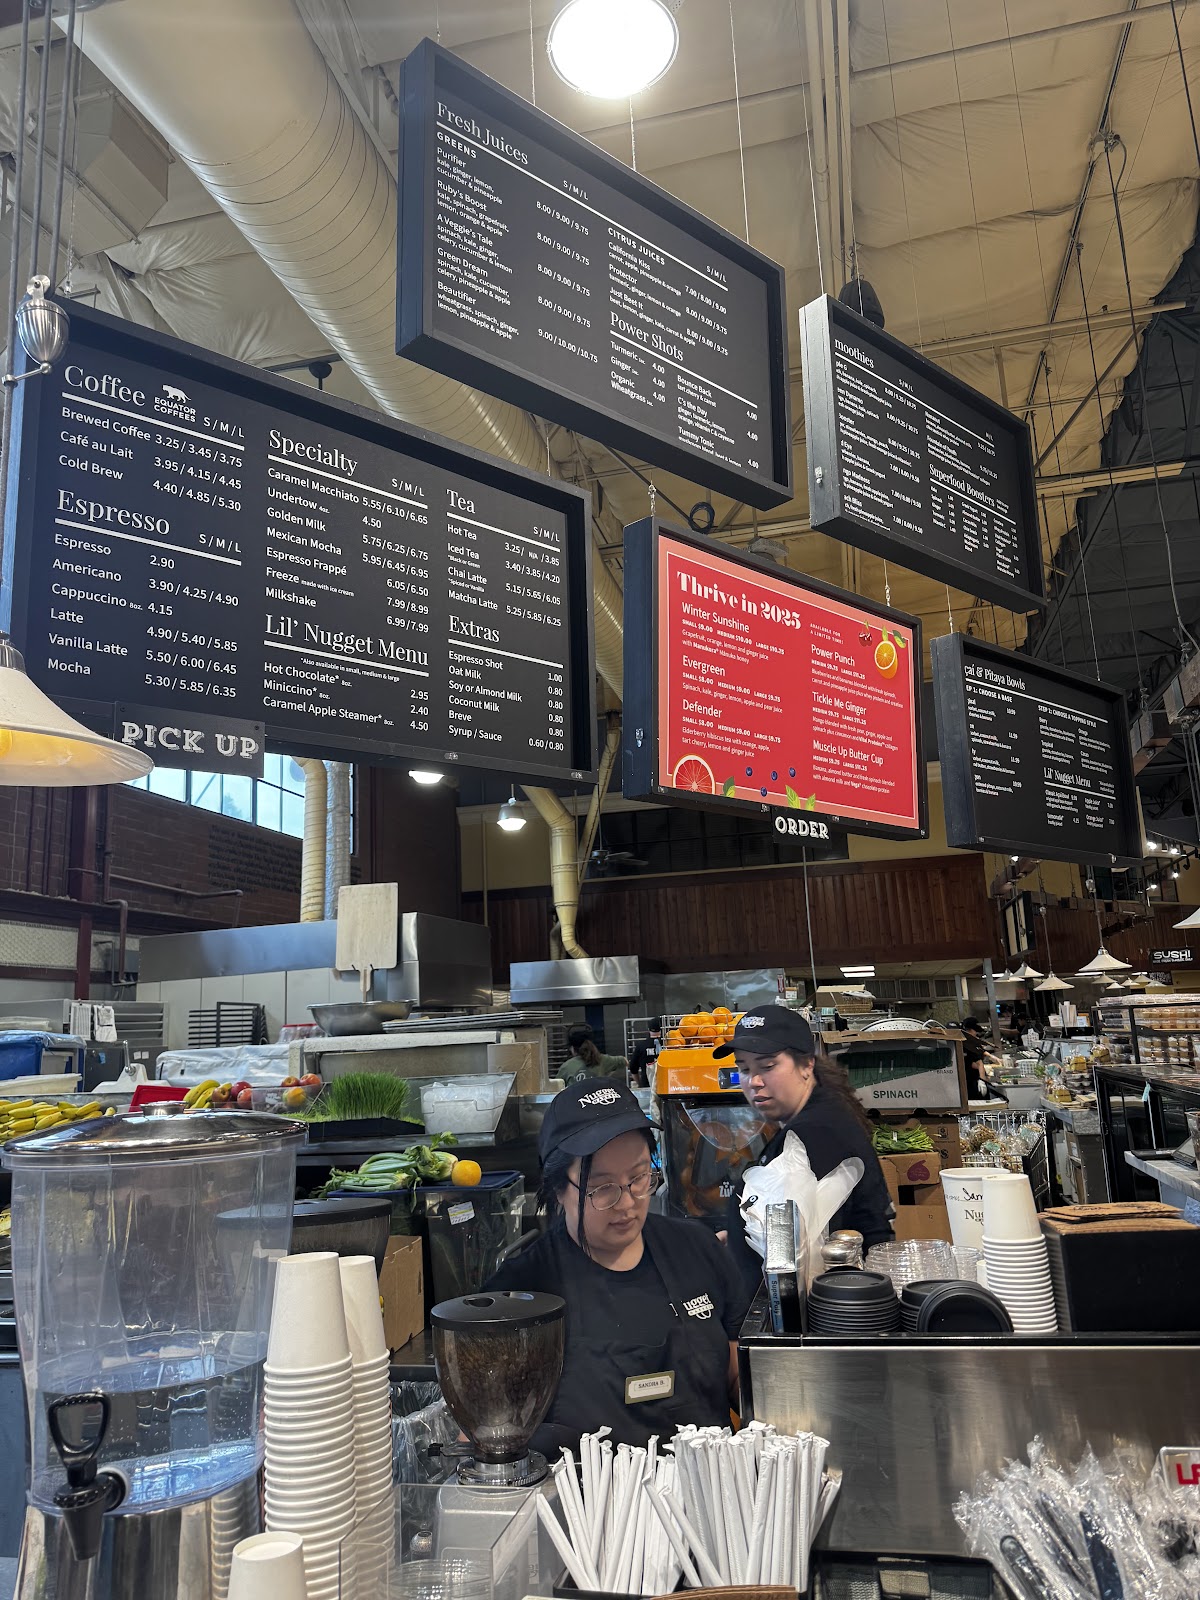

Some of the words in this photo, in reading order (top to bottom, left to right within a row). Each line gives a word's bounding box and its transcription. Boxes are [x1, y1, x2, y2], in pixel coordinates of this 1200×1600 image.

[437, 102, 481, 140] Fresh
[482, 129, 528, 164] Juices
[437, 132, 476, 159] GREENS
[437, 147, 466, 168] Purifier
[437, 180, 463, 201] Ruby's
[465, 194, 487, 211] Boost
[437, 214, 443, 222] A
[477, 233, 493, 247] Tale
[608, 228, 636, 248] CITRUS
[639, 246, 665, 265] JUICES
[609, 241, 637, 264] California
[639, 258, 650, 270] Kiss
[437, 248, 461, 264] Green
[463, 259, 488, 277] Dream
[609, 264, 637, 284] Protector
[438, 281, 476, 307] Beautifier
[610, 287, 623, 299] Just
[624, 294, 637, 307] Beet
[638, 302, 643, 310] It
[611, 311, 649, 343] Power
[652, 333, 683, 361] Shots
[611, 341, 638, 360] Turmeric
[835, 339, 874, 368] moothies
[611, 356, 631, 371] Ginger
[65, 366, 145, 406] Coffee
[611, 371, 635, 388] Organic
[611, 380, 646, 403] Wheatgrass
[154, 397, 196, 416] EQUATOR
[154, 403, 196, 422] COFFEES
[62, 407, 109, 429] Brewed
[113, 422, 150, 441] Coffee
[61, 431, 88, 447] Café
[92, 442, 106, 452] au
[111, 444, 133, 459] Lait
[678, 426, 699, 443] Tummy
[700, 436, 714, 448] Tonic
[268, 430, 358, 477] Specialty
[59, 455, 88, 471] Cold
[92, 463, 123, 479] Brew
[268, 468, 309, 488] Caramel
[312, 481, 359, 503] Macchiato
[930, 464, 965, 493] Superfood
[967, 483, 995, 507] Boosters
[267, 487, 317, 510] Undertow
[447, 489, 475, 514] Tea
[57, 488, 169, 534] Espresso
[267, 507, 303, 525] Golden
[306, 518, 326, 531] Milk
[362, 516, 381, 528] 4.50
[267, 527, 307, 546] Mexican
[310, 538, 341, 555] Mocha
[448, 524, 462, 536] Hot
[463, 529, 477, 540] Tea
[55, 534, 111, 555] Espresso
[448, 543, 464, 555] Iced
[466, 548, 479, 559] Tea
[53, 559, 121, 581] Americano
[150, 555, 174, 569] 2.90
[267, 547, 311, 566] Espresso
[314, 559, 346, 575] Frappé
[266, 567, 299, 583] Freeze
[448, 567, 465, 578] Chai
[468, 572, 487, 584] Latte
[52, 583, 127, 606] Cappuccino
[266, 587, 316, 607] Milkshake
[449, 590, 477, 604] Matcha
[479, 598, 498, 610] Latte
[677, 571, 738, 608] Thrive
[742, 593, 757, 615] in
[760, 601, 801, 629] 2025
[51, 608, 83, 623] Latte
[148, 603, 172, 615] 4.15
[682, 602, 710, 620] Winter
[713, 612, 749, 633] Sunshine
[449, 615, 499, 642] Extras
[682, 619, 697, 628] SMALL
[49, 633, 92, 650] Vanilla
[96, 641, 127, 656] Latte
[304, 623, 374, 654] Nugget
[378, 639, 428, 665] Menu
[811, 644, 833, 659] Power
[835, 652, 855, 666] Punch
[48, 658, 90, 674] Mocha
[265, 662, 283, 674] Hot
[449, 651, 484, 665] Espresso
[485, 659, 503, 670] Shot
[683, 655, 725, 676] Evergreen
[449, 665, 463, 676] Oat
[465, 669, 481, 679] Milk
[548, 673, 562, 682] 1.00
[964, 664, 975, 676] çaí
[976, 667, 983, 677] &
[984, 669, 1005, 685] Pitaya
[1006, 675, 1025, 690] Bowls
[411, 689, 428, 700] 2.95
[449, 680, 464, 692] Soy
[475, 686, 505, 698] Almond
[507, 691, 522, 702] Milk
[548, 686, 563, 696] 0.80
[979, 688, 997, 698] CHOOSE
[263, 696, 306, 712] Caramel
[308, 704, 337, 717] Apple
[411, 705, 428, 715] 2.40
[449, 695, 482, 709] Coconut
[484, 701, 499, 712] Milk
[548, 700, 563, 709] 0.80
[683, 699, 722, 718] Defender
[812, 691, 832, 706] Tickle
[834, 698, 844, 709] Me
[845, 701, 866, 716] Ginger
[410, 721, 428, 731] 4.50
[449, 710, 472, 721] Breve
[549, 714, 563, 723] 0.80
[121, 721, 205, 753] PICK
[215, 734, 259, 759] UP
[549, 728, 563, 737] 0.80
[813, 740, 836, 754] Muscle
[838, 746, 848, 758] Up
[849, 748, 870, 761] Butter
[871, 753, 883, 766] Cup
[775, 816, 829, 839] ORDER
[577, 1087, 618, 1108] Nugget
[873, 1090, 918, 1099] SPINACH
